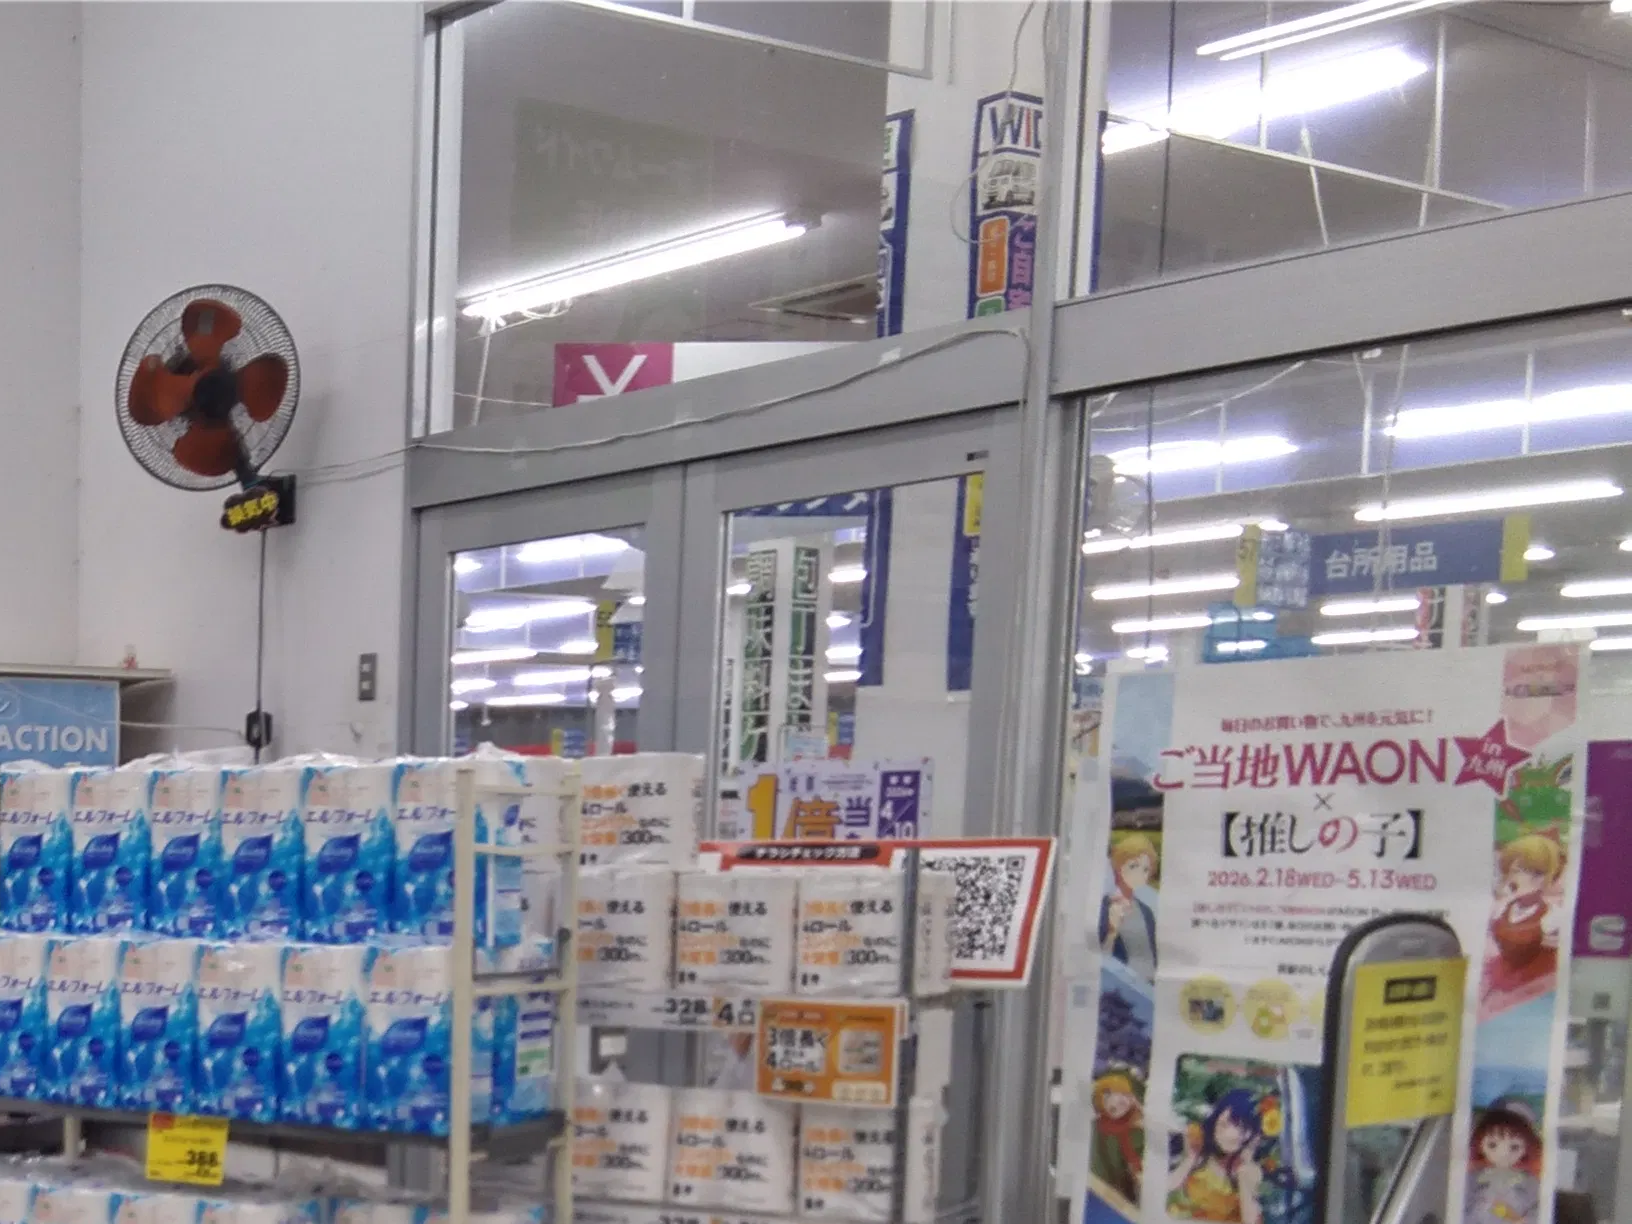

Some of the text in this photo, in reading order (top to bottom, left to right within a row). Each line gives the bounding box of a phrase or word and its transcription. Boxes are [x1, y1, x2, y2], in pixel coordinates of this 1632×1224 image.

[1325, 541, 1439, 579] 台所用品
[1152, 735, 1449, 791] ご当地WAON
[397, 806, 457, 822] エルフォー
[1221, 808, 1425, 861] 【推しの子】
